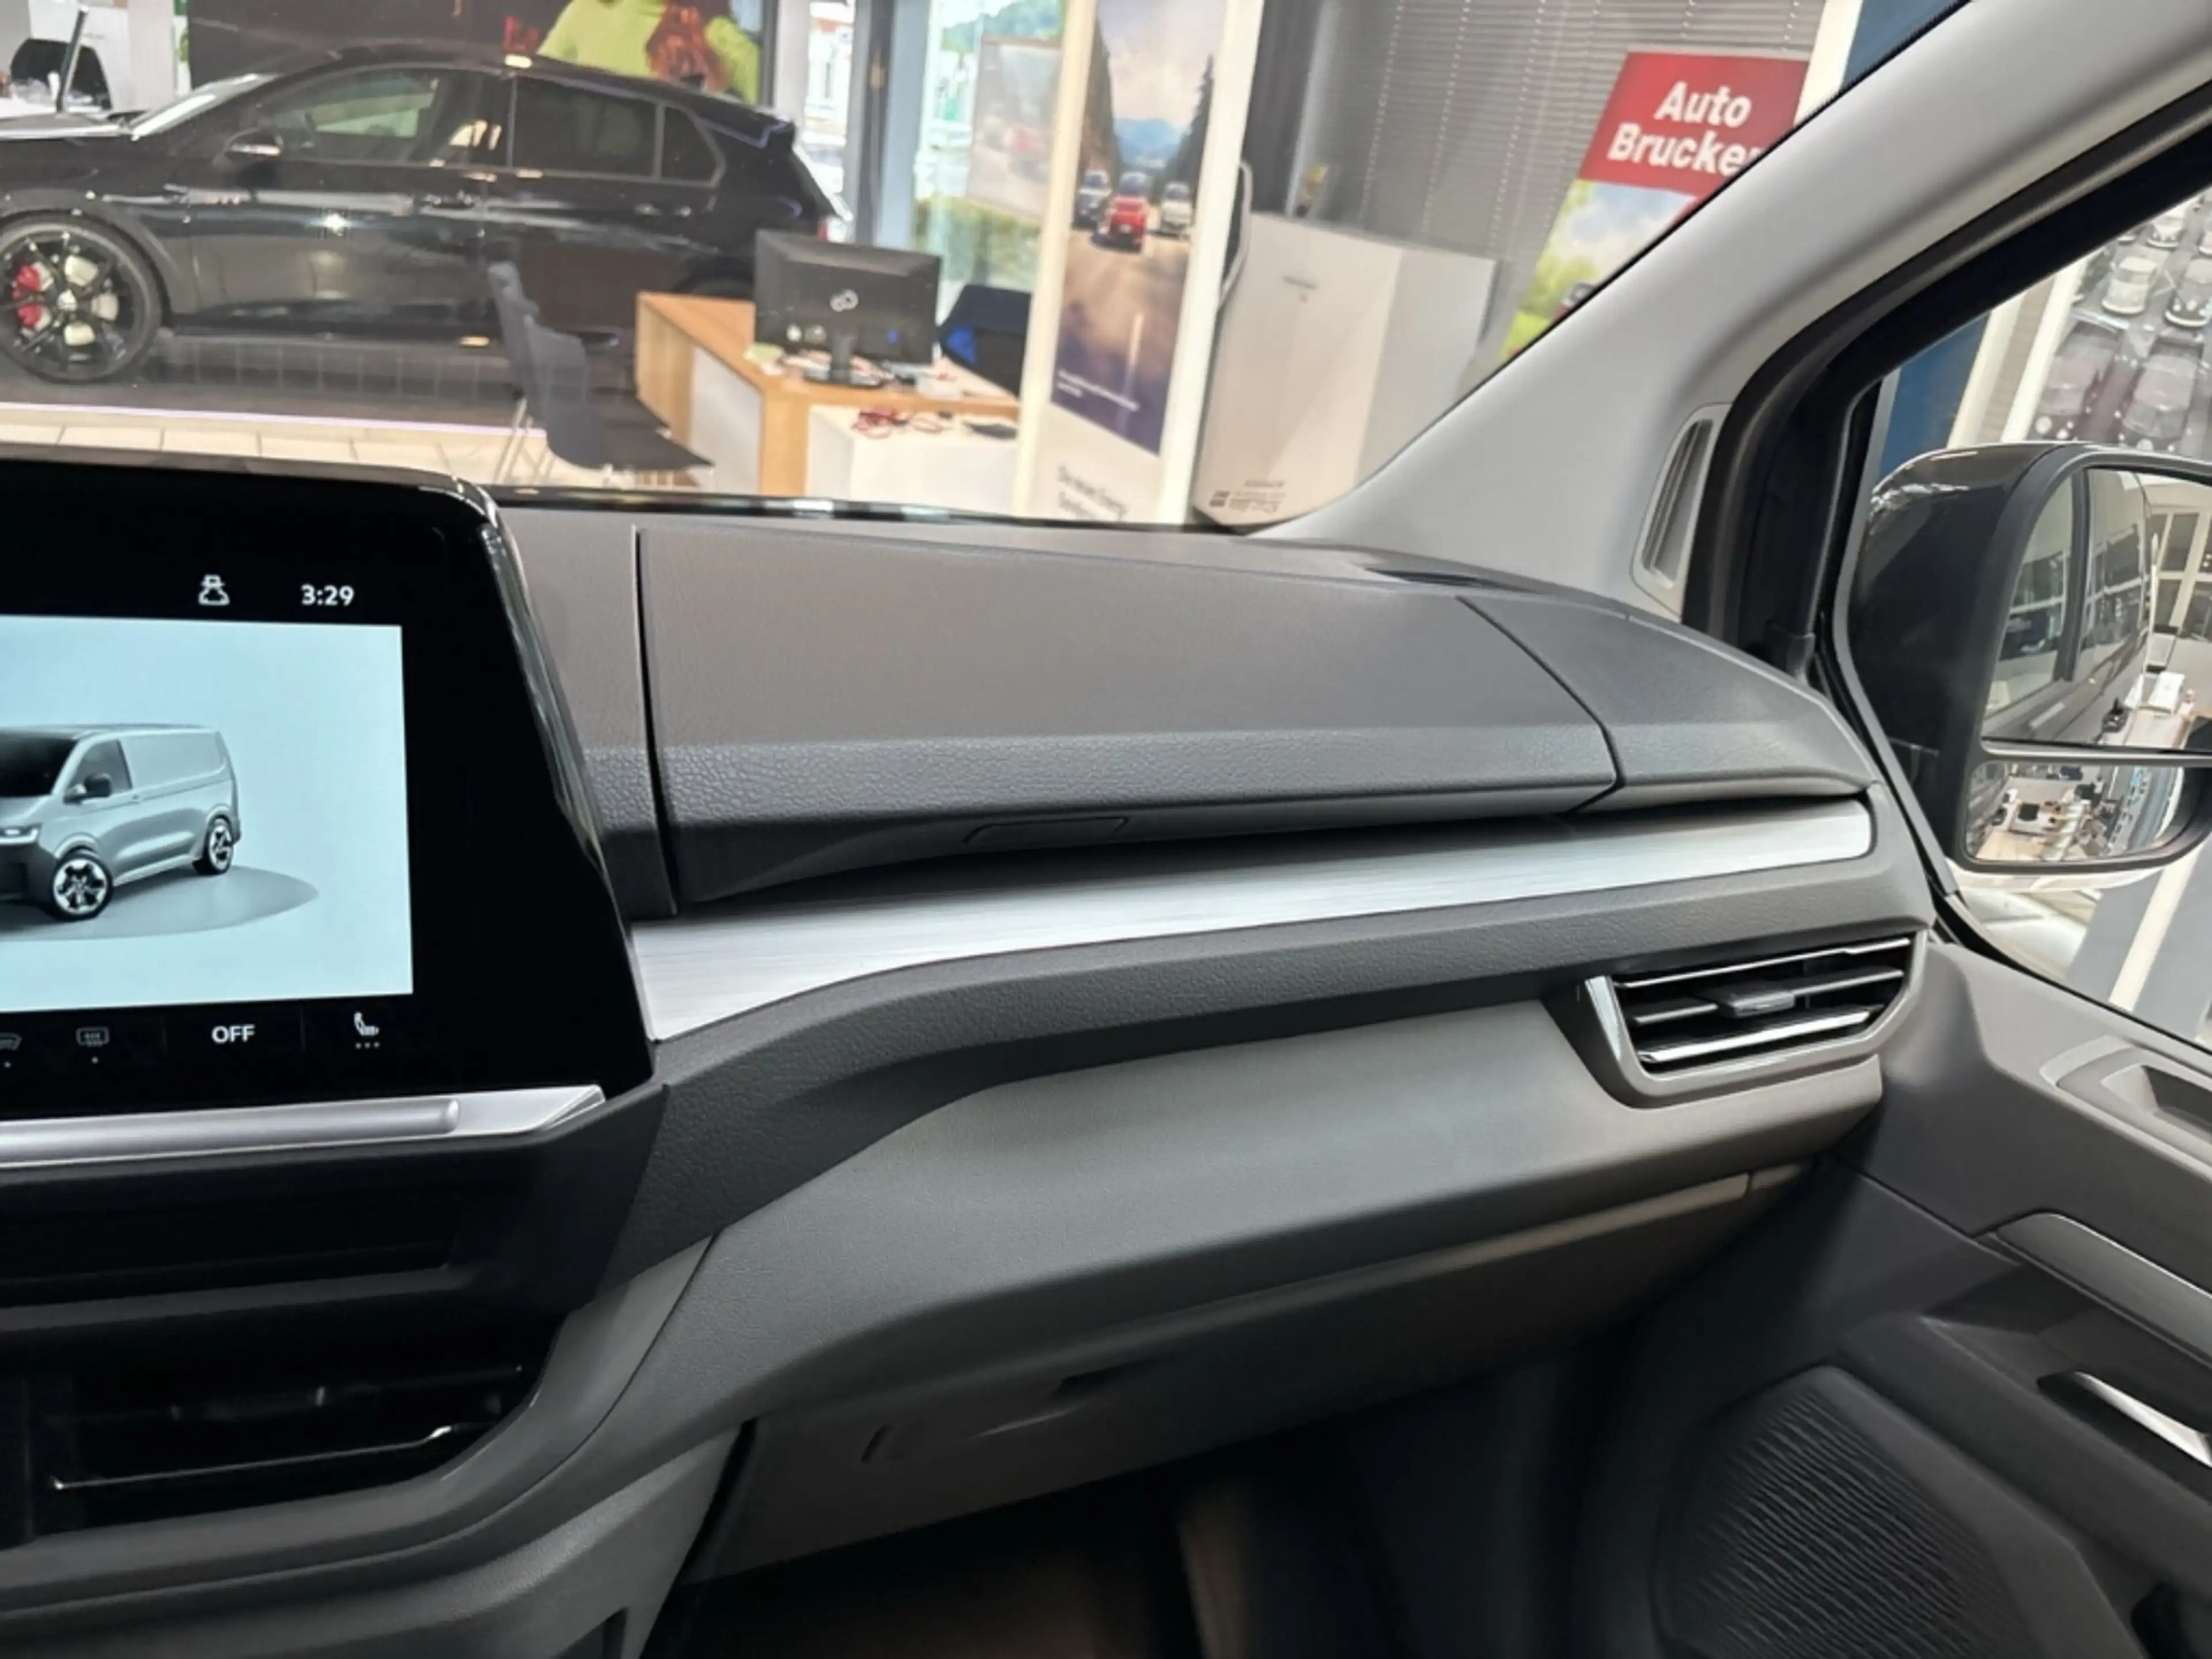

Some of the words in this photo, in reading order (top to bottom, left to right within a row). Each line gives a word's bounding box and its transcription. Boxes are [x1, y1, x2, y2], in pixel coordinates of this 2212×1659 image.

[1653, 81, 1752, 128] Auto
[300, 584, 355, 606] 3:29
[211, 1024, 255, 1043] OFF
